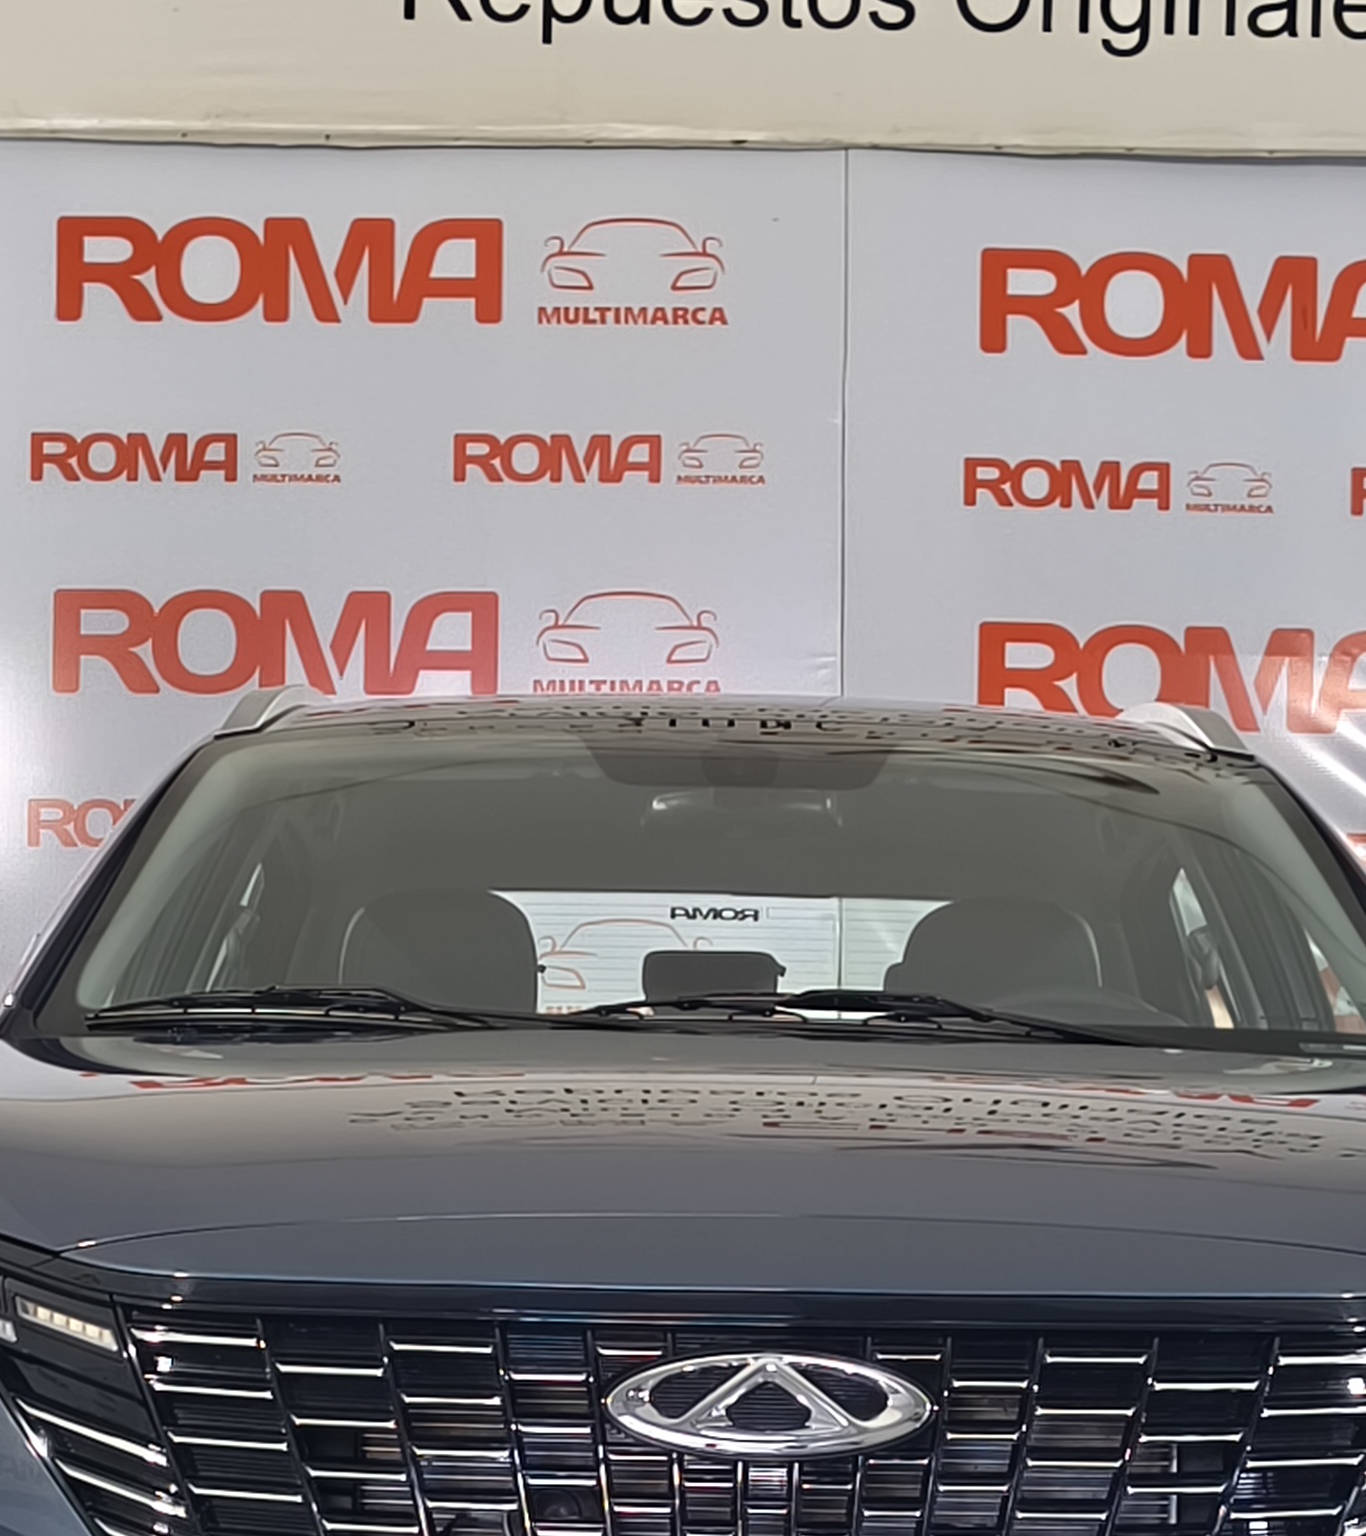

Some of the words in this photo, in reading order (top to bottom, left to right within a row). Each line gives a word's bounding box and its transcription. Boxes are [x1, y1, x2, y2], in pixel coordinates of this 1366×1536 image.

[55, 216, 504, 325] ROMA
[537, 306, 728, 326] MULTIMARCA
[29, 432, 238, 483] ROMA
[453, 433, 663, 485] ROMA
[963, 457, 1172, 512] ROMA
[52, 589, 500, 695] ROMA
[27, 799, 135, 848] RO
